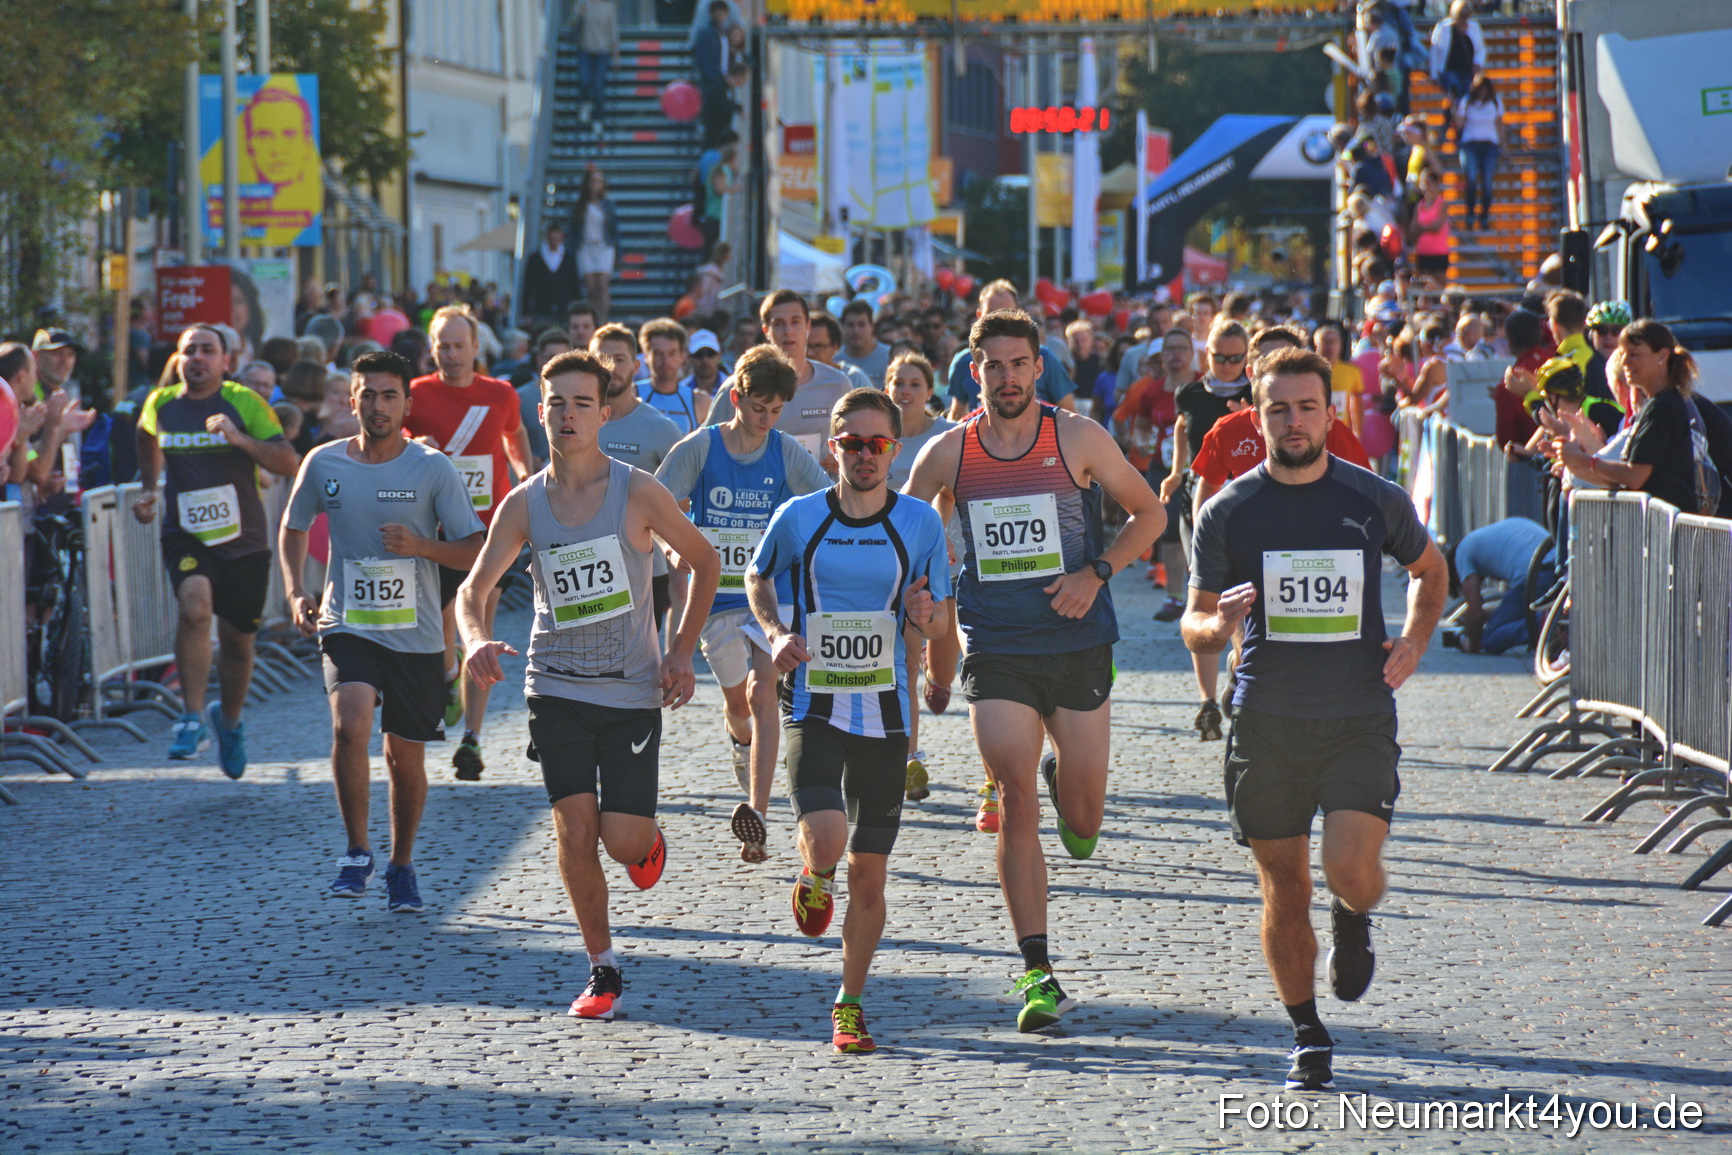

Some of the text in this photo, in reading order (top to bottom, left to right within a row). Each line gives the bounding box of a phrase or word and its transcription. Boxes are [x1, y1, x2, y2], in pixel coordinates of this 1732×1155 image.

[159, 431, 229, 449] BOCK
[607, 442, 640, 452] BOCK
[377, 490, 417, 500] BOCK
[735, 492, 770, 501] LEIDL &
[734, 500, 773, 509] INDERST
[993, 504, 1031, 516] BOCK
[188, 502, 230, 524] 5203
[706, 514, 728, 527] TSG
[730, 518, 745, 527] 08
[719, 533, 748, 541] BOCK
[985, 518, 1046, 547] 5079
[559, 547, 596, 563] BOCK
[1010, 547, 1037, 555] Neumarkt
[1001, 559, 1037, 571] Philipp
[1292, 558, 1335, 569] BOCK
[362, 566, 394, 575] BOCK
[553, 559, 614, 595] 5173
[354, 578, 406, 602] 5152
[580, 589, 606, 599] Neumarkt
[1278, 575, 1349, 604] 5194
[577, 602, 605, 617] Marc
[1306, 606, 1335, 614] Neumarkt
[832, 619, 873, 629] BOCK
[820, 634, 882, 660] 5000
[826, 672, 876, 686] Christoph
